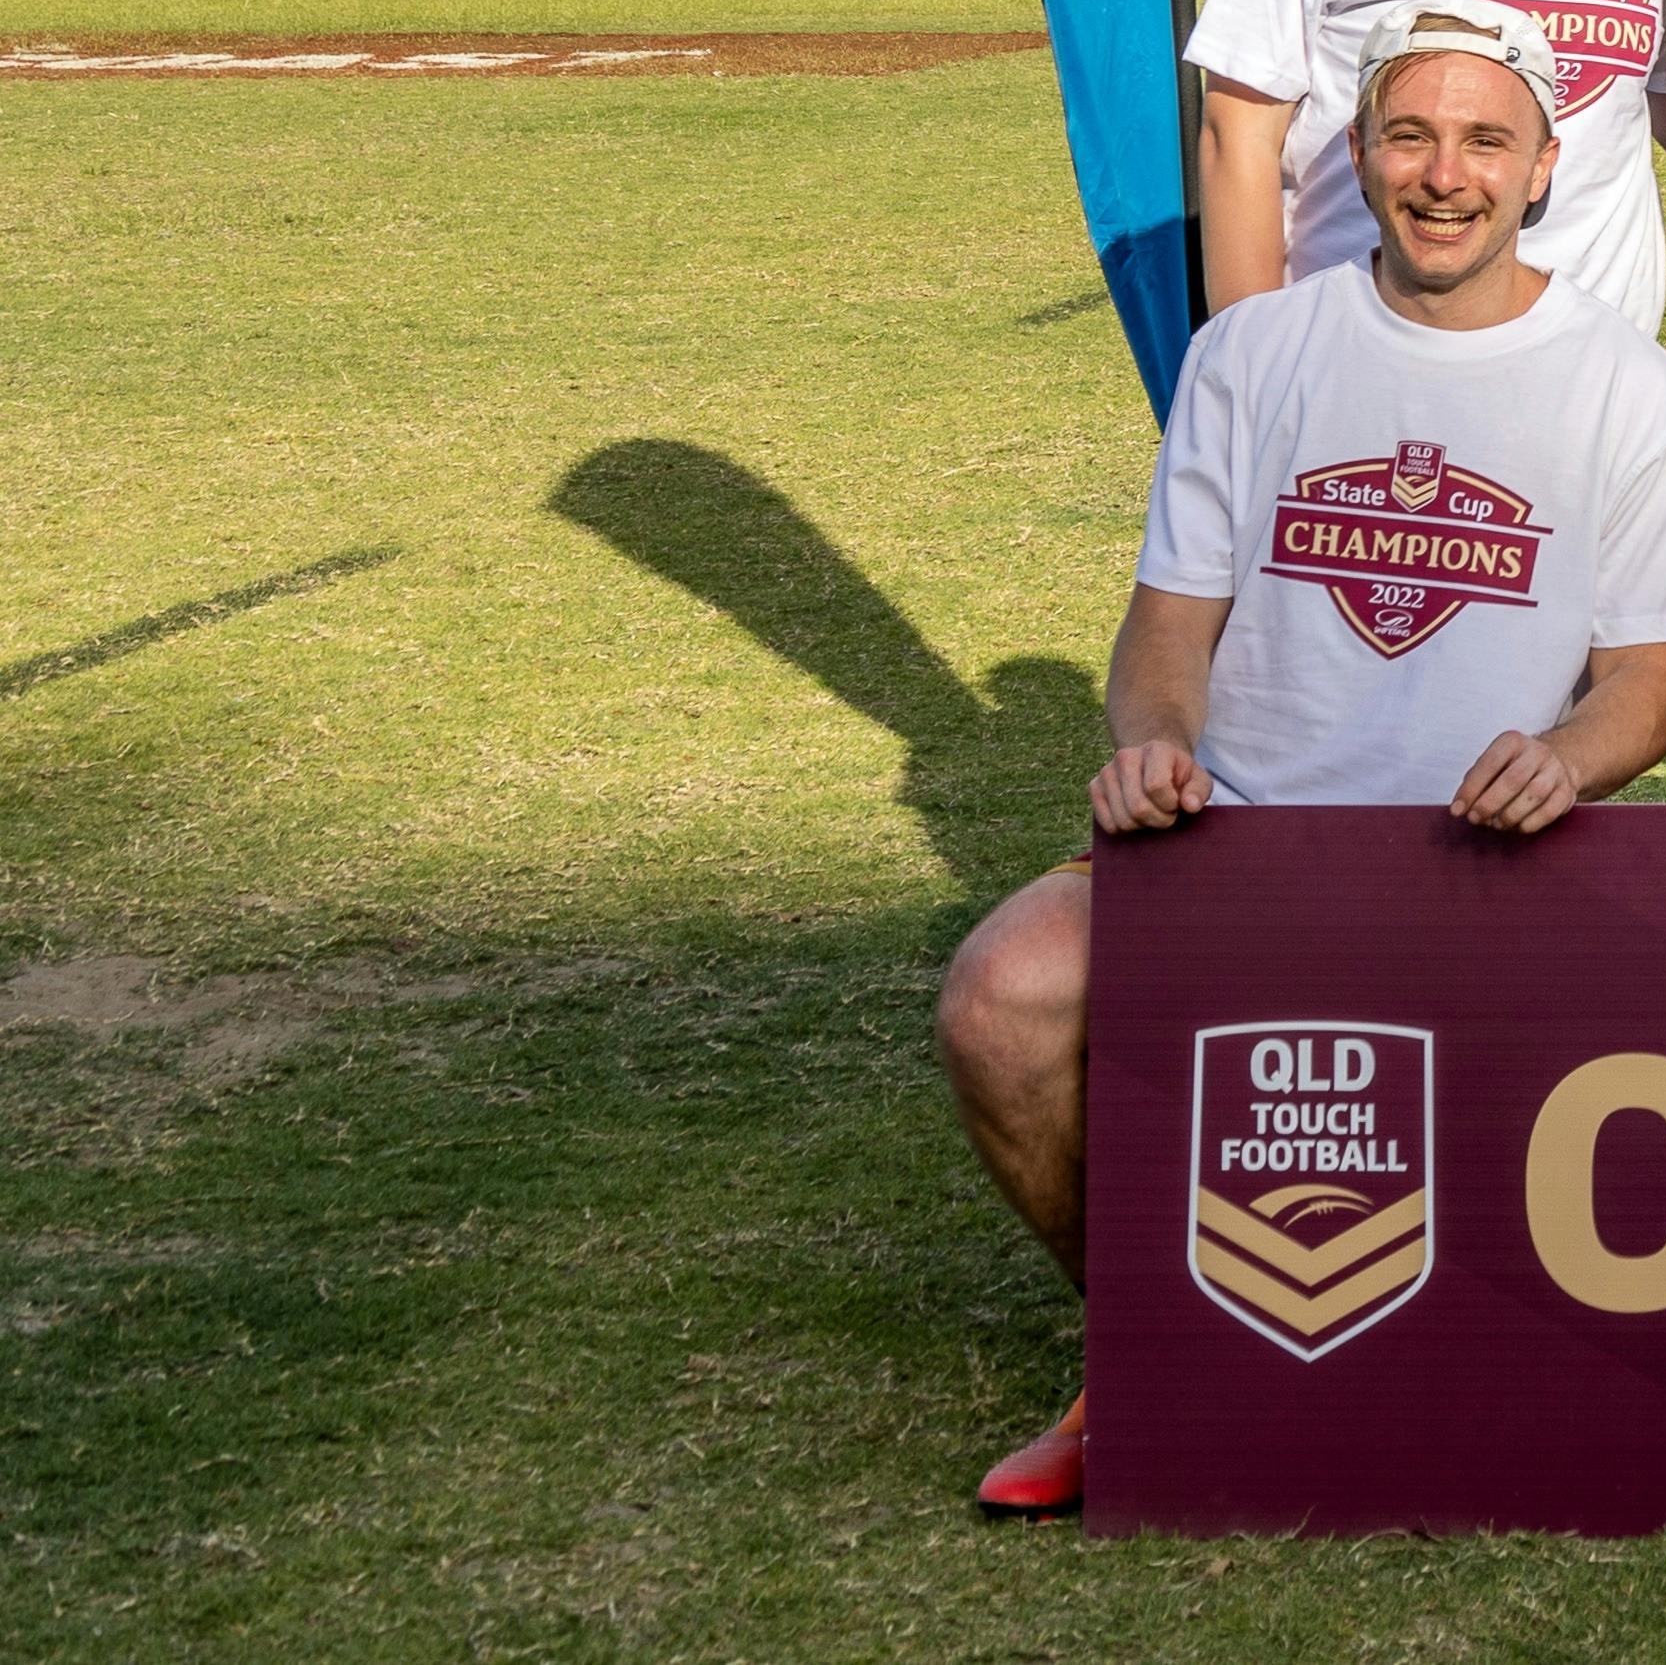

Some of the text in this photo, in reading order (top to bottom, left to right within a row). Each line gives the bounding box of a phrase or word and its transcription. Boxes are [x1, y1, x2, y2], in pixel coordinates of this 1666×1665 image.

[1529, 11, 1651, 54] MPIONS
[1407, 445, 1434, 459] QLD
[1323, 480, 1494, 522] State Cup
[1284, 521, 1522, 579] CHAMPIONS
[1368, 584, 1426, 609] 2022
[1249, 1038, 1376, 1094] QLD
[1250, 1103, 1376, 1135] TOUCH
[1220, 1139, 1408, 1172] FOOTBALL
